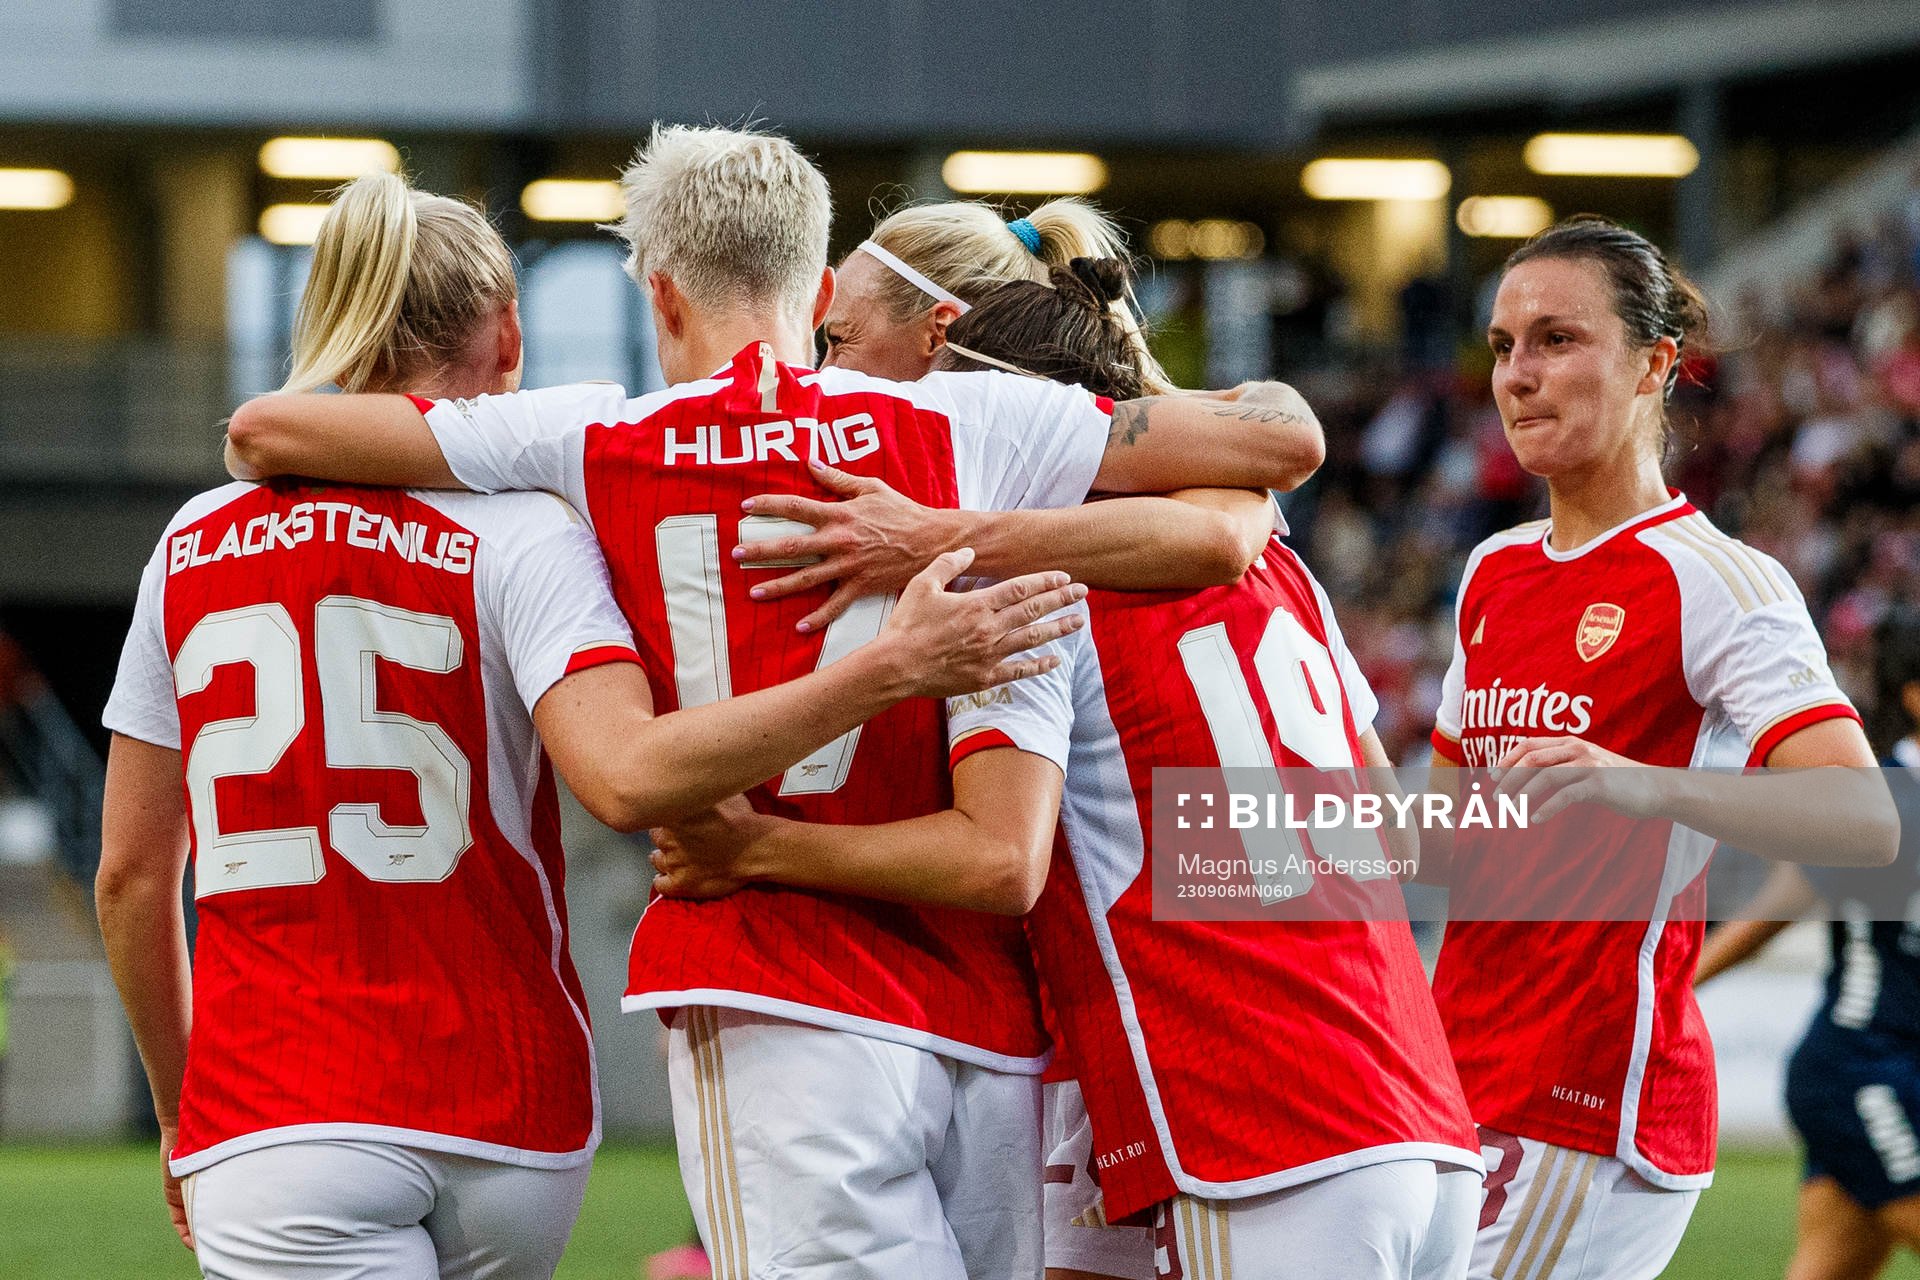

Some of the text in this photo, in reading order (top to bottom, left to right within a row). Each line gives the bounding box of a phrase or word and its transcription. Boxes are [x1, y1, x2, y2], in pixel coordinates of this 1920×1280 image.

[664, 412, 880, 466] HURTIG
[168, 502, 475, 575] BLACKSTENIUS
[1462, 677, 1594, 734] mirates
[173, 595, 474, 900] 25
[1177, 606, 1393, 906] 19
[1552, 1085, 1606, 1111] HEAT.RDY
[1096, 1140, 1147, 1170] HEAT.RDY
